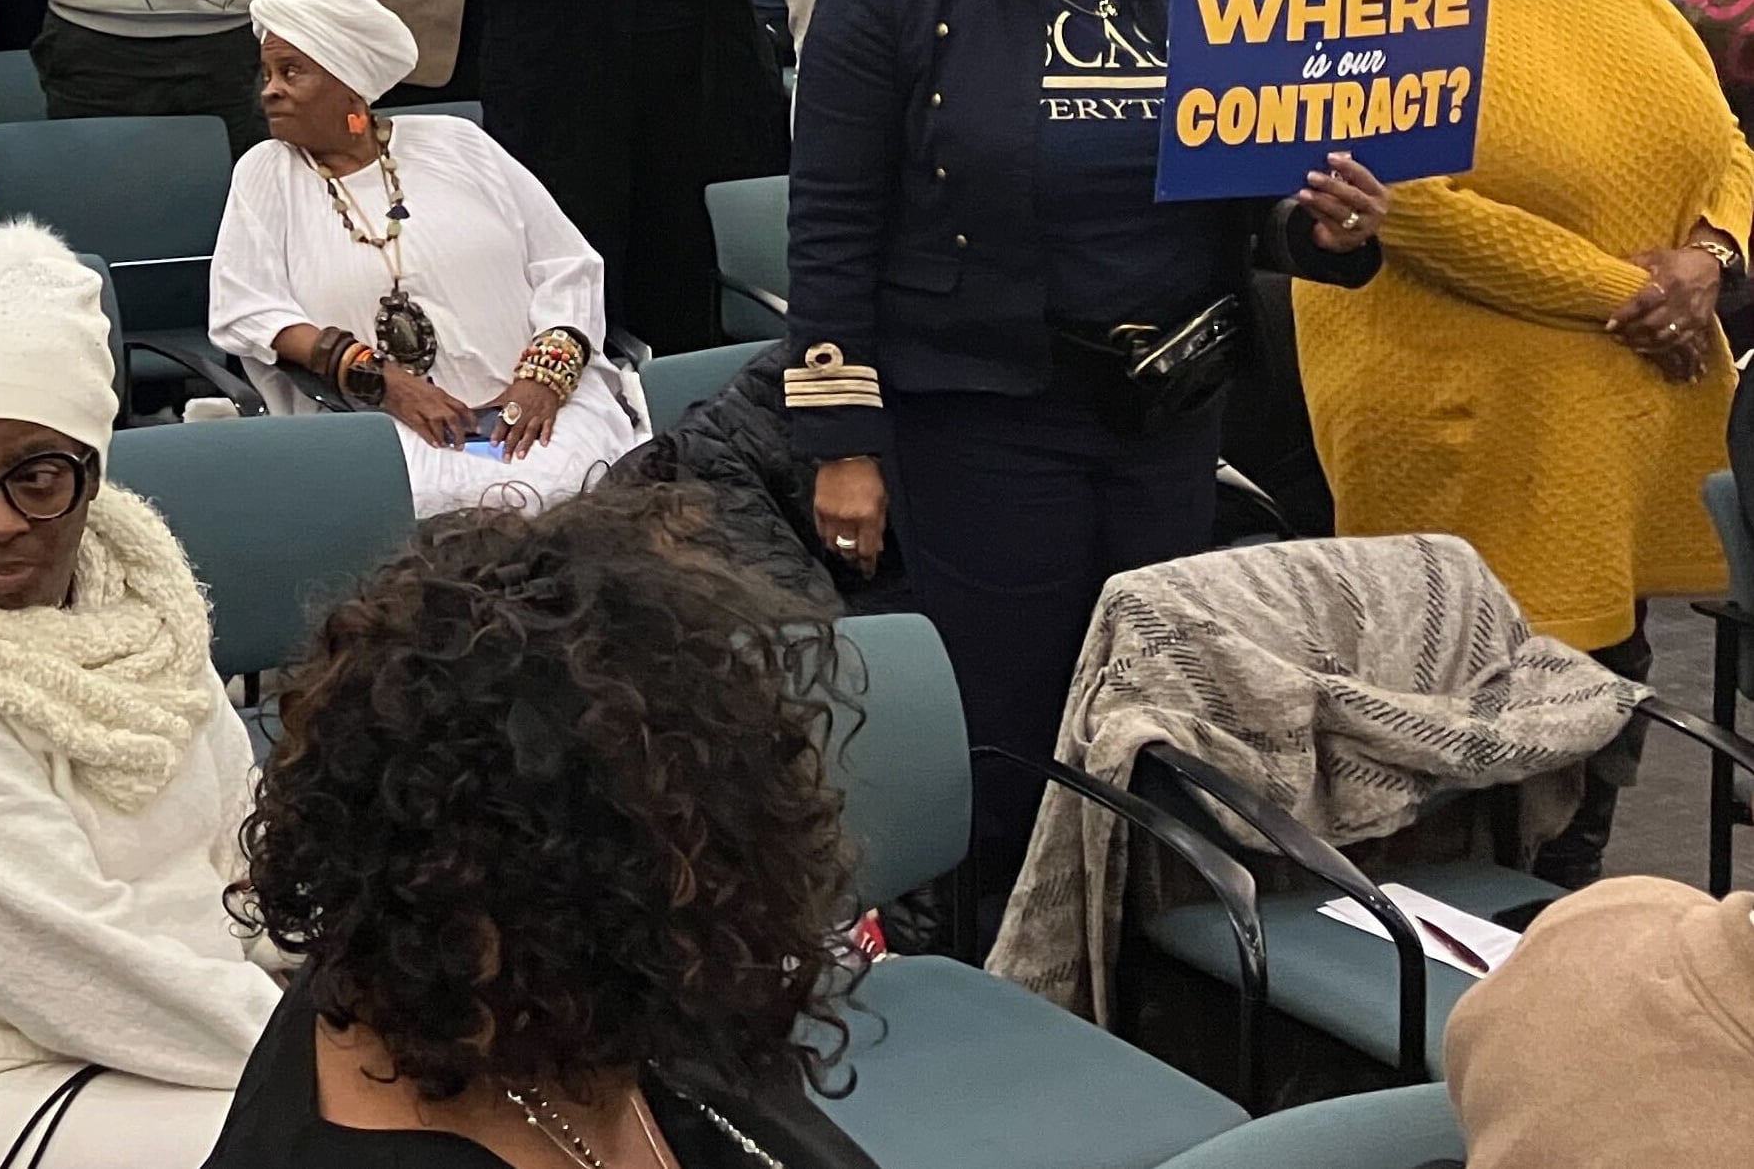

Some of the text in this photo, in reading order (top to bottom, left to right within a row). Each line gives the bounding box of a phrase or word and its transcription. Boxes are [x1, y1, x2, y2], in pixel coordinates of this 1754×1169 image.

[1302, 41, 1387, 79] is our
[1176, 66, 1471, 147] CONTRACT?
